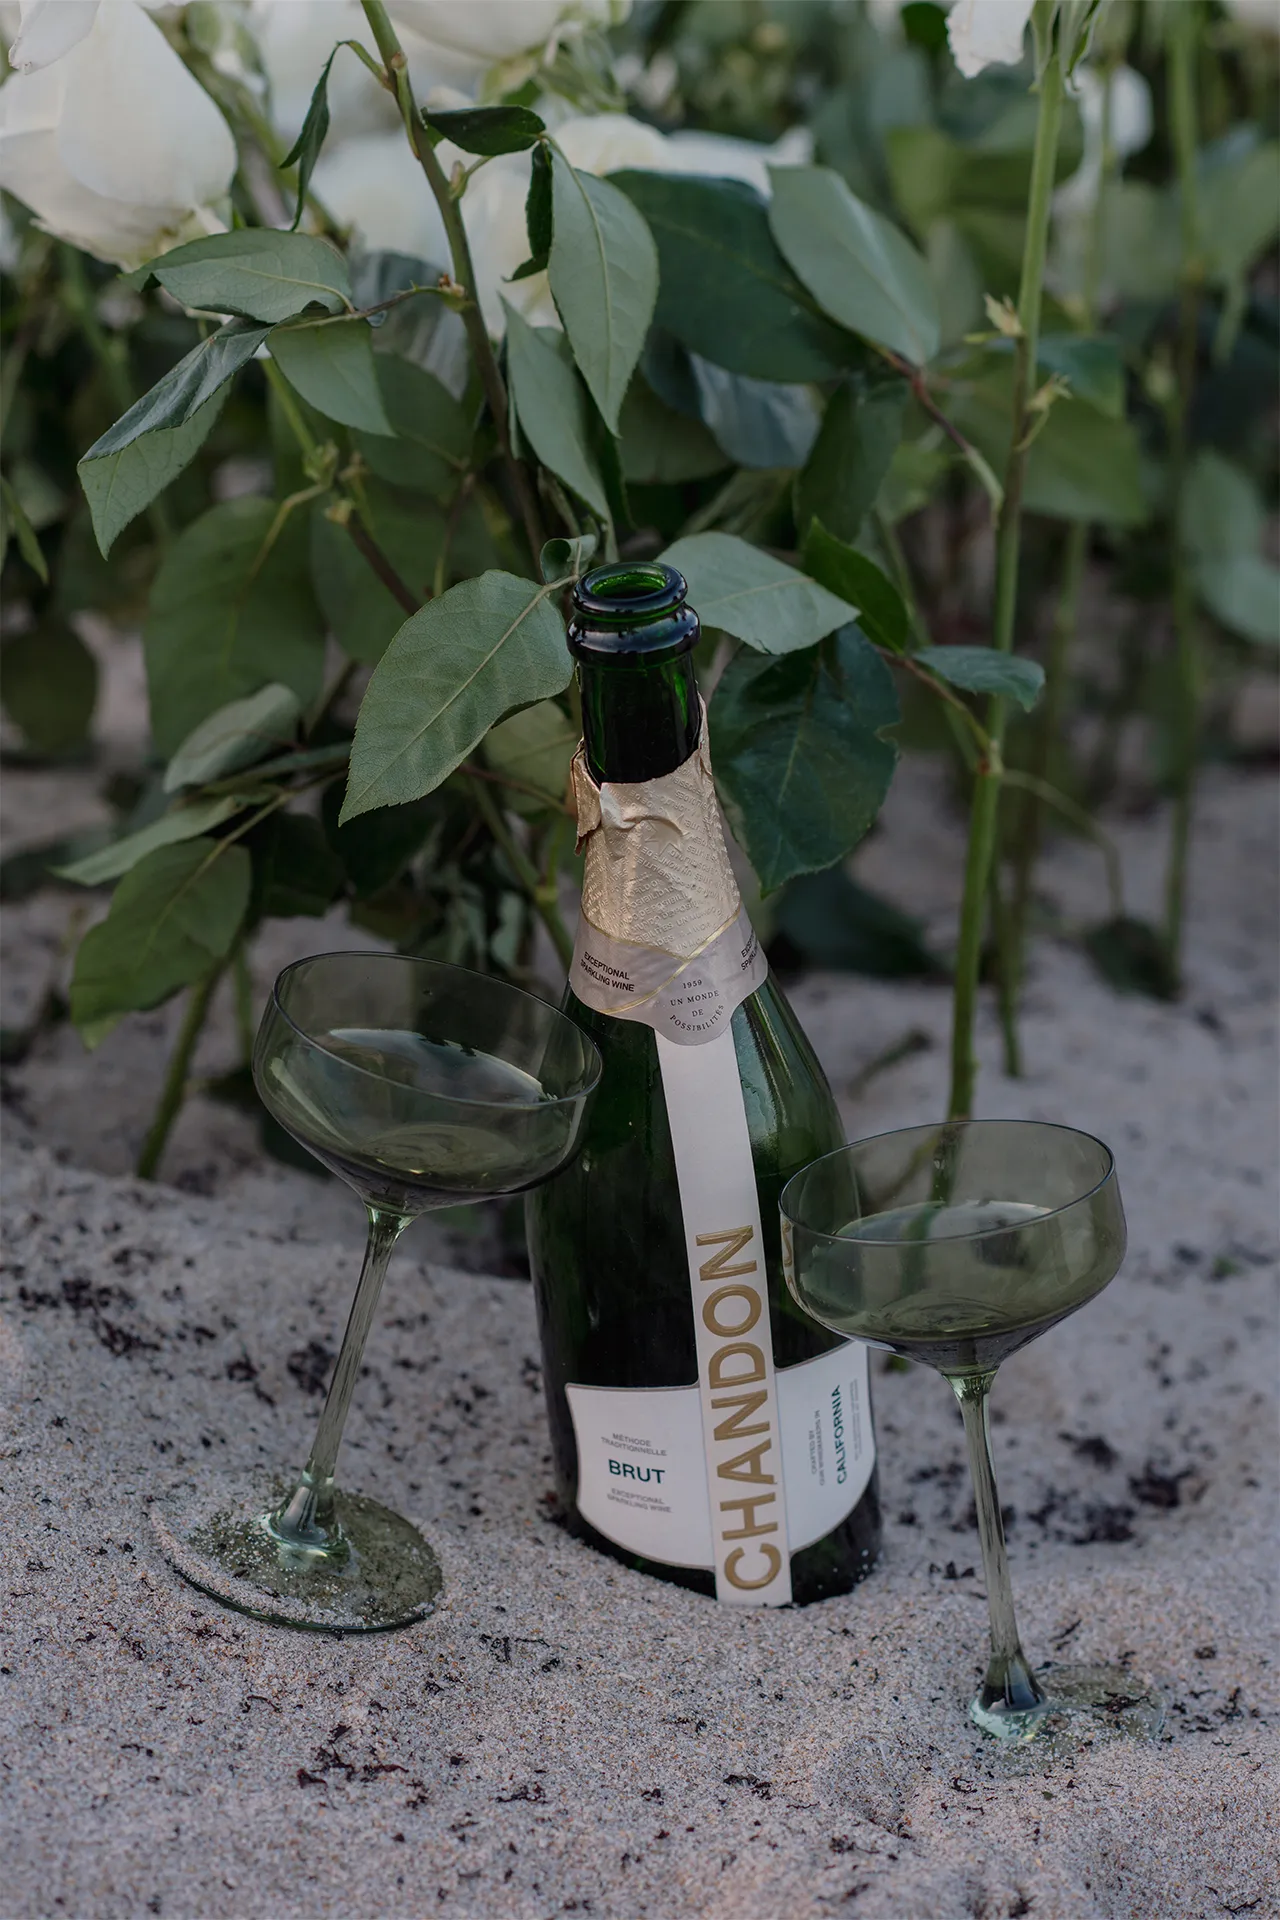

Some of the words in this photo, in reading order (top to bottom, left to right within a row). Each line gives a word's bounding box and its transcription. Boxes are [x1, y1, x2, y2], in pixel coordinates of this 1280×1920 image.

[580, 959, 611, 986] SPARKLING
[611, 979, 635, 993] WINE
[583, 951, 630, 981] EXCEPTIONAL
[670, 998, 684, 1007] UN
[687, 989, 720, 1005] MONDE
[682, 979, 703, 990] 1959
[691, 1008, 704, 1018] DE
[695, 1224, 783, 1591] CHANDON
[831, 1384, 847, 1485] CALIFORNIA
[608, 1458, 666, 1484] BRUT
